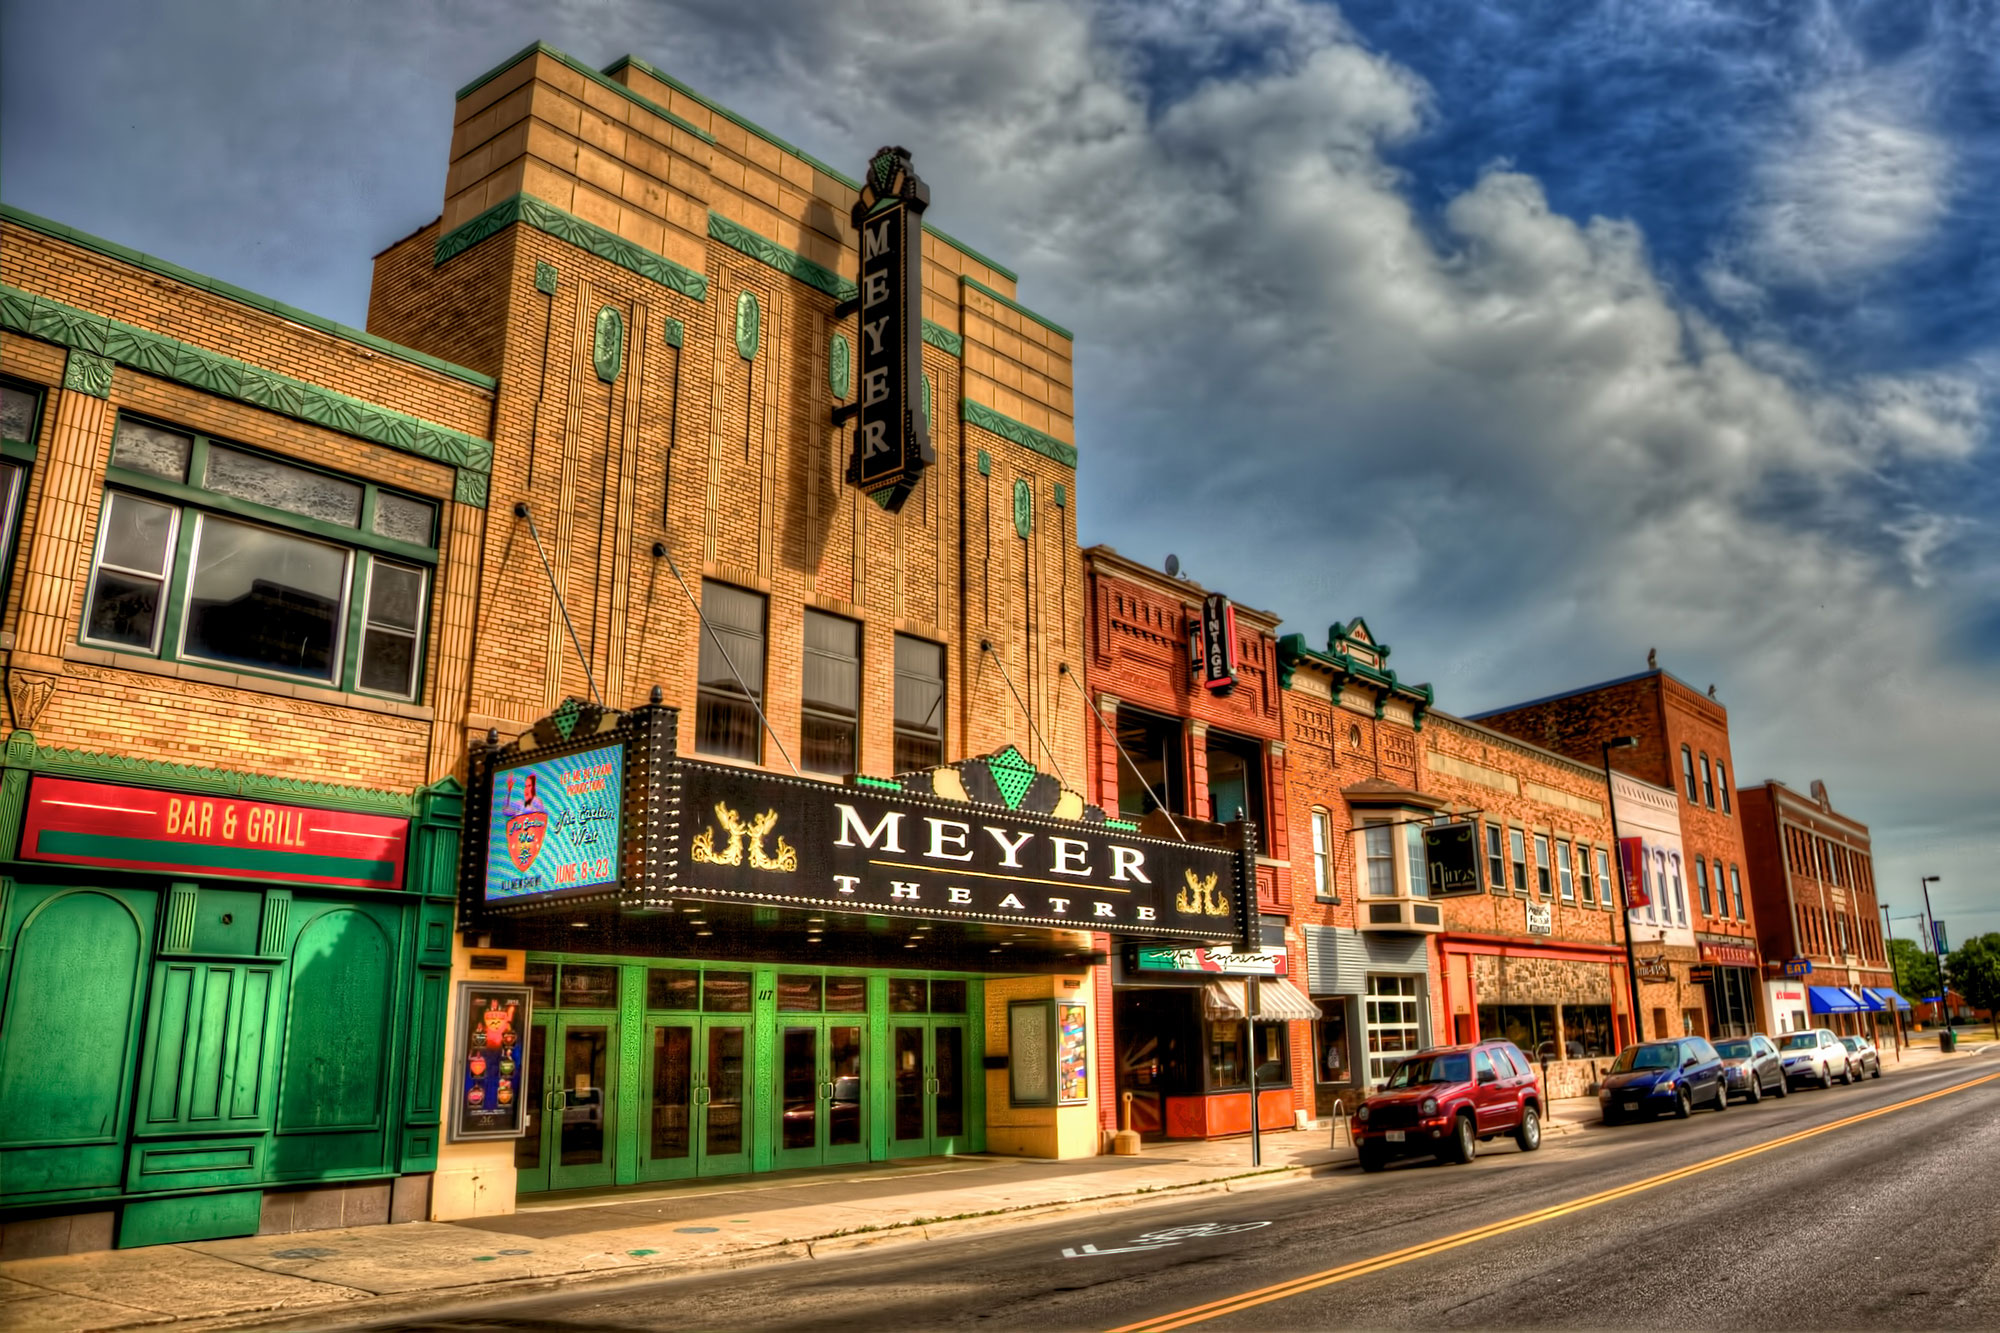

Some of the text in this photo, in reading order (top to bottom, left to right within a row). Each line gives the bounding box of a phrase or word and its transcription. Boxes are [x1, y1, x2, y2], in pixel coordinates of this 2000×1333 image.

[864, 220, 890, 460] MEYER
[1207, 596, 1222, 678] VINTAGE
[559, 771, 571, 785] LET
[572, 768, 582, 782] ME
[583, 767, 592, 780] BE
[166, 798, 306, 847] BAR & GRILL
[833, 803, 1152, 884] MEYER
[555, 863, 577, 884] JUNE
[833, 875, 1156, 921] THEATRE
[1785, 962, 1809, 975] EAT
[758, 990, 773, 1000] 117
